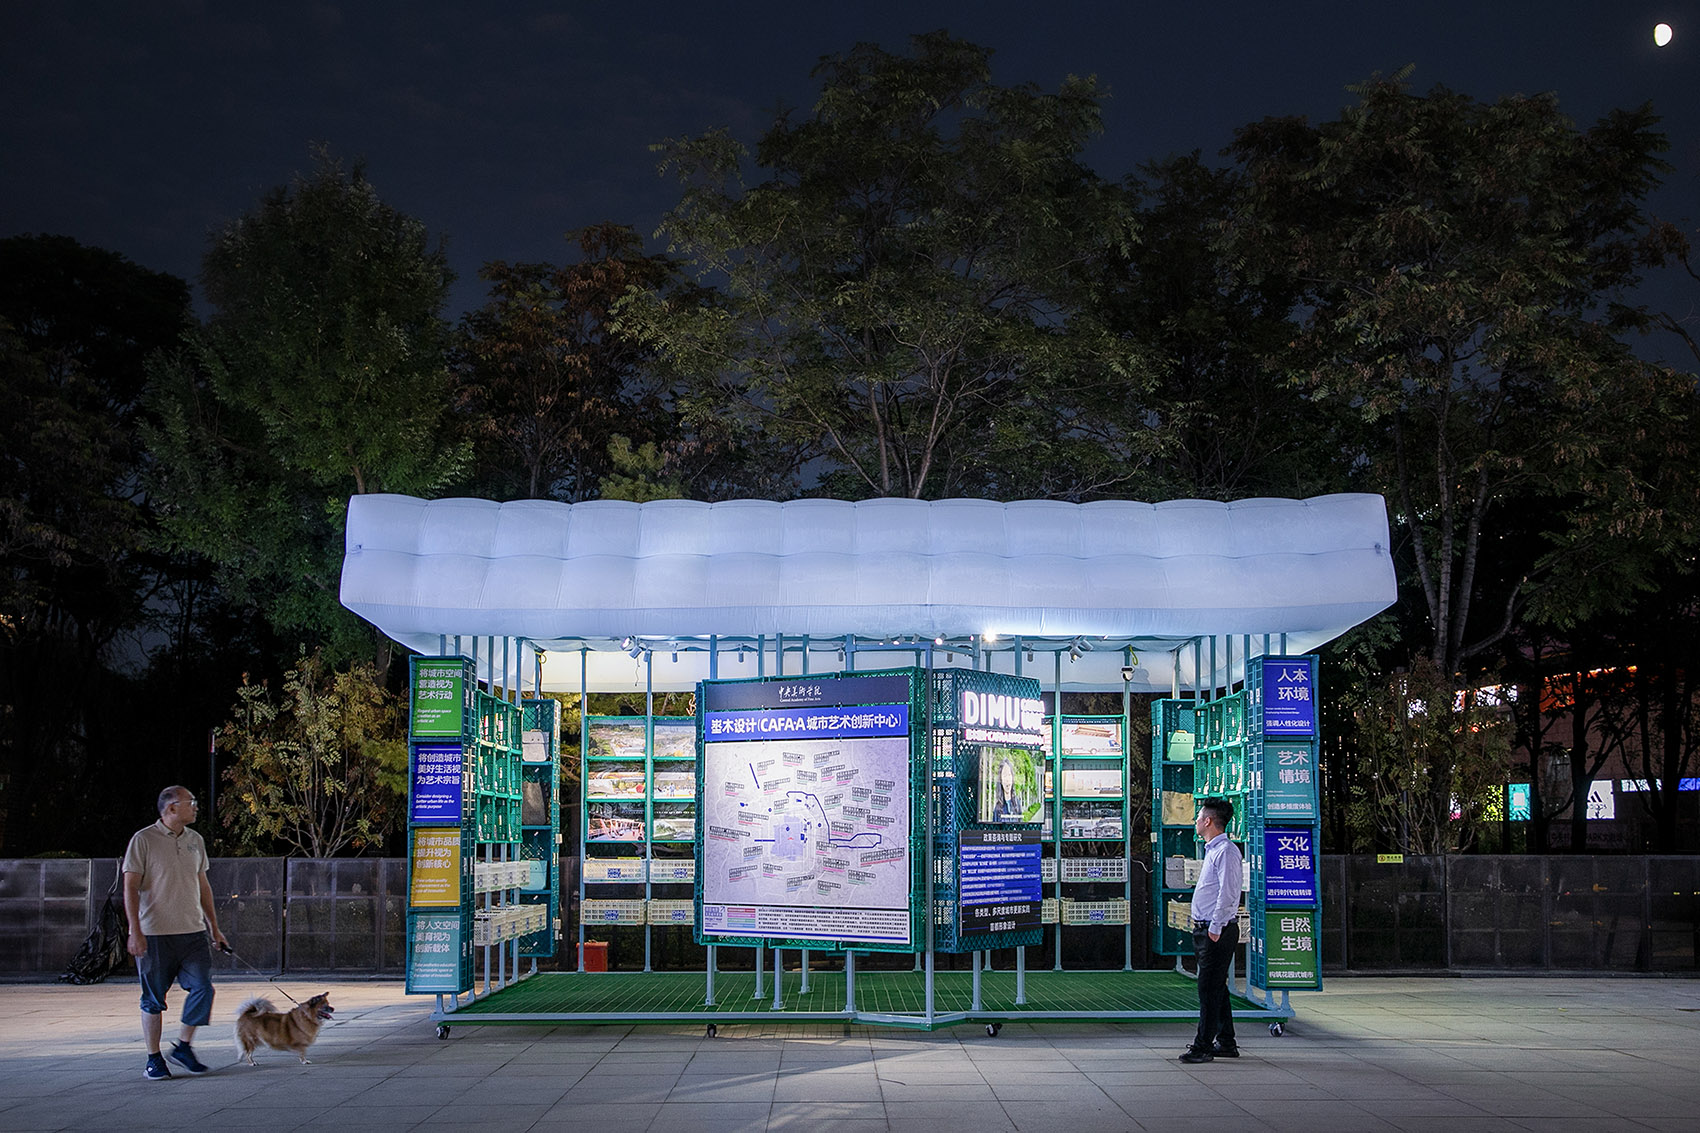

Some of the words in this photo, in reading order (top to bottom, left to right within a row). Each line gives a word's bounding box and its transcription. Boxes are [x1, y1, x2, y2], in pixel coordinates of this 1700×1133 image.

[420, 668, 462, 678] 将城市空间
[1278, 668, 1308, 682] 人本
[418, 690, 453, 700] 艺术行动
[1278, 686, 1310, 701] 环境
[964, 691, 1020, 729] DIMU
[418, 753, 461, 762] 将创造城市
[1278, 750, 1309, 765] 艺术
[418, 764, 461, 774] 美好生活视
[416, 776, 460, 784] 为艺术宗旨
[1279, 769, 1310, 784] 情境
[418, 837, 460, 846] 将城市品质
[1278, 836, 1309, 851] 文化
[417, 848, 451, 857] 提升视为
[416, 859, 451, 868] 创新核心
[1279, 855, 1310, 869] 语境
[416, 921, 460, 930] 将人文空间
[1281, 917, 1311, 932] 自然
[416, 932, 450, 941] 美育视为
[415, 944, 450, 952] 创新载体
[1281, 936, 1312, 951] 生境
